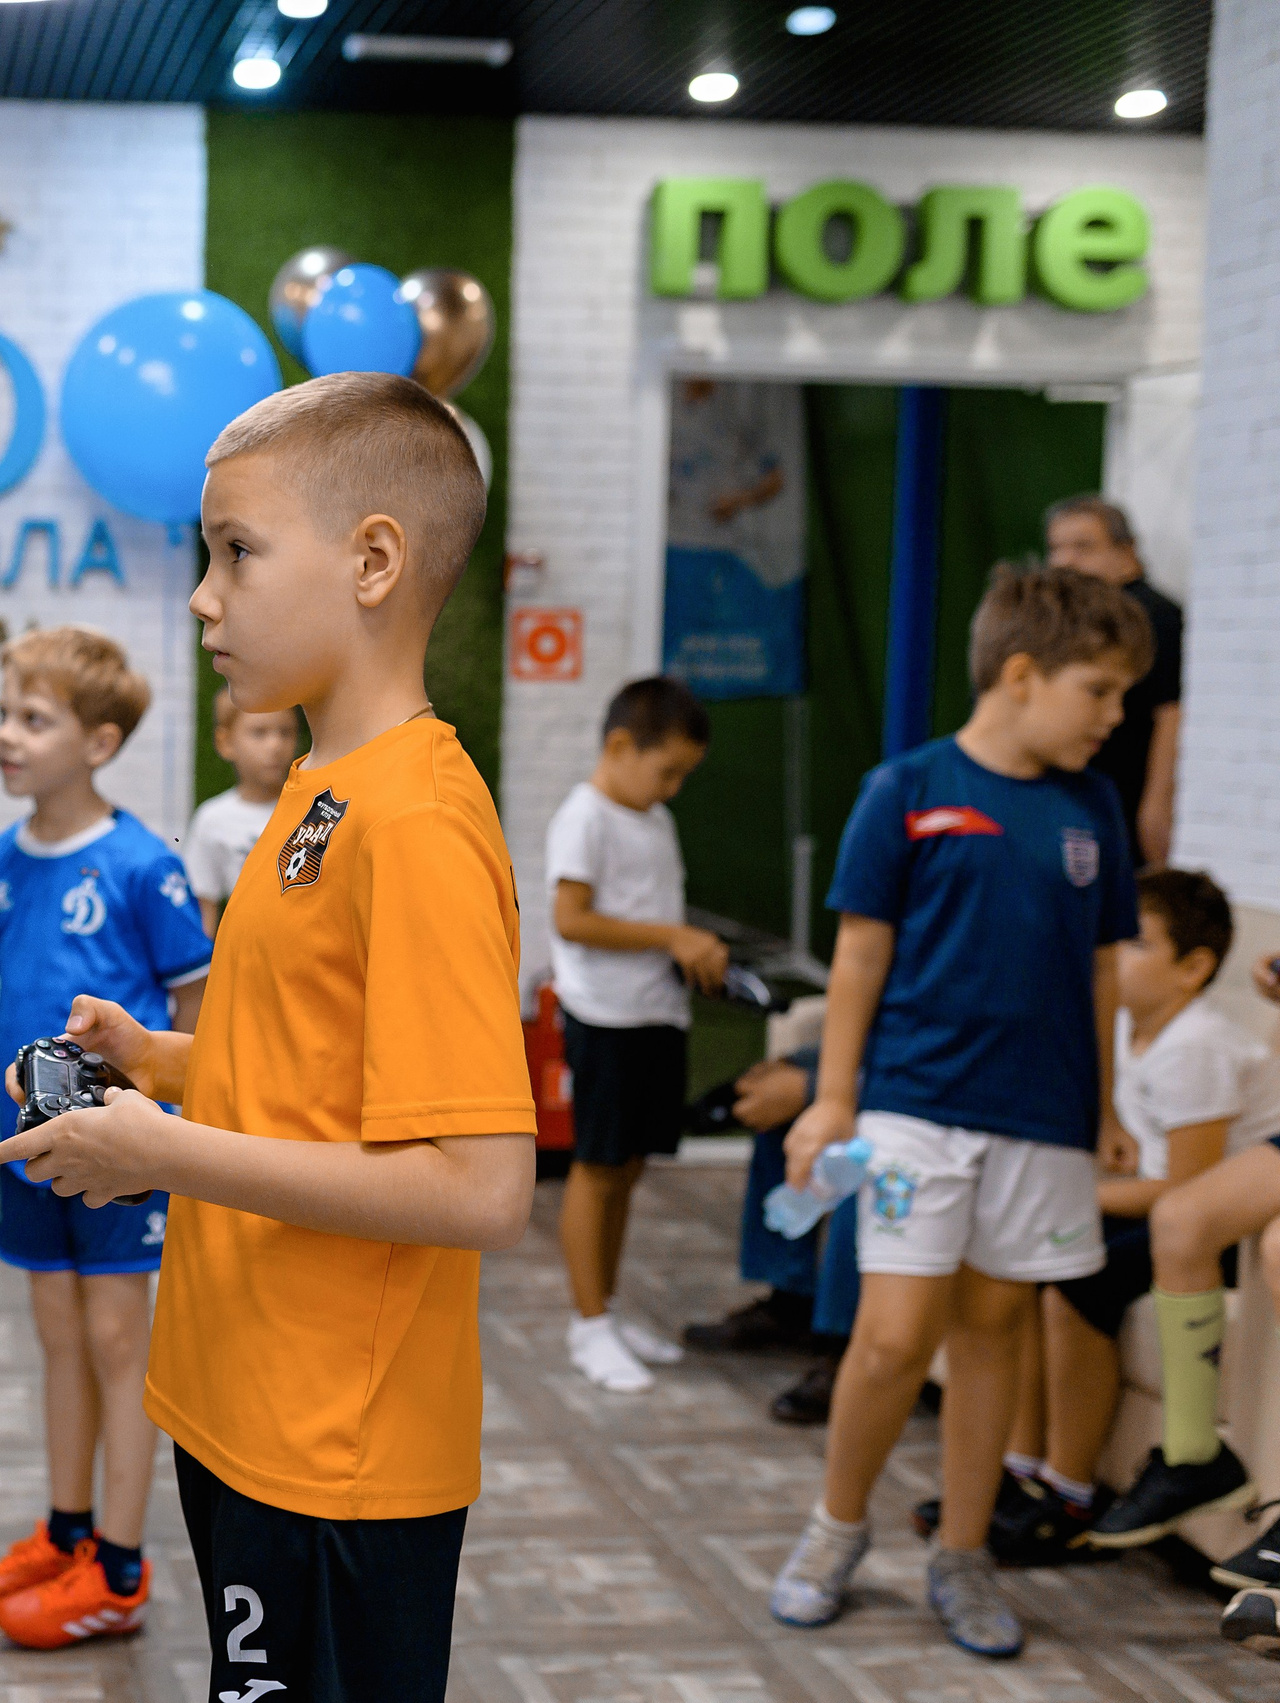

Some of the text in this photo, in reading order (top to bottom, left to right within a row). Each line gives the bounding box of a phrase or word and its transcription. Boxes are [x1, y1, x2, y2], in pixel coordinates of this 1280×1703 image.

[650, 177, 1152, 312] поле
[291, 821, 335, 846] УРАЛ
[223, 1584, 268, 1664] 2
